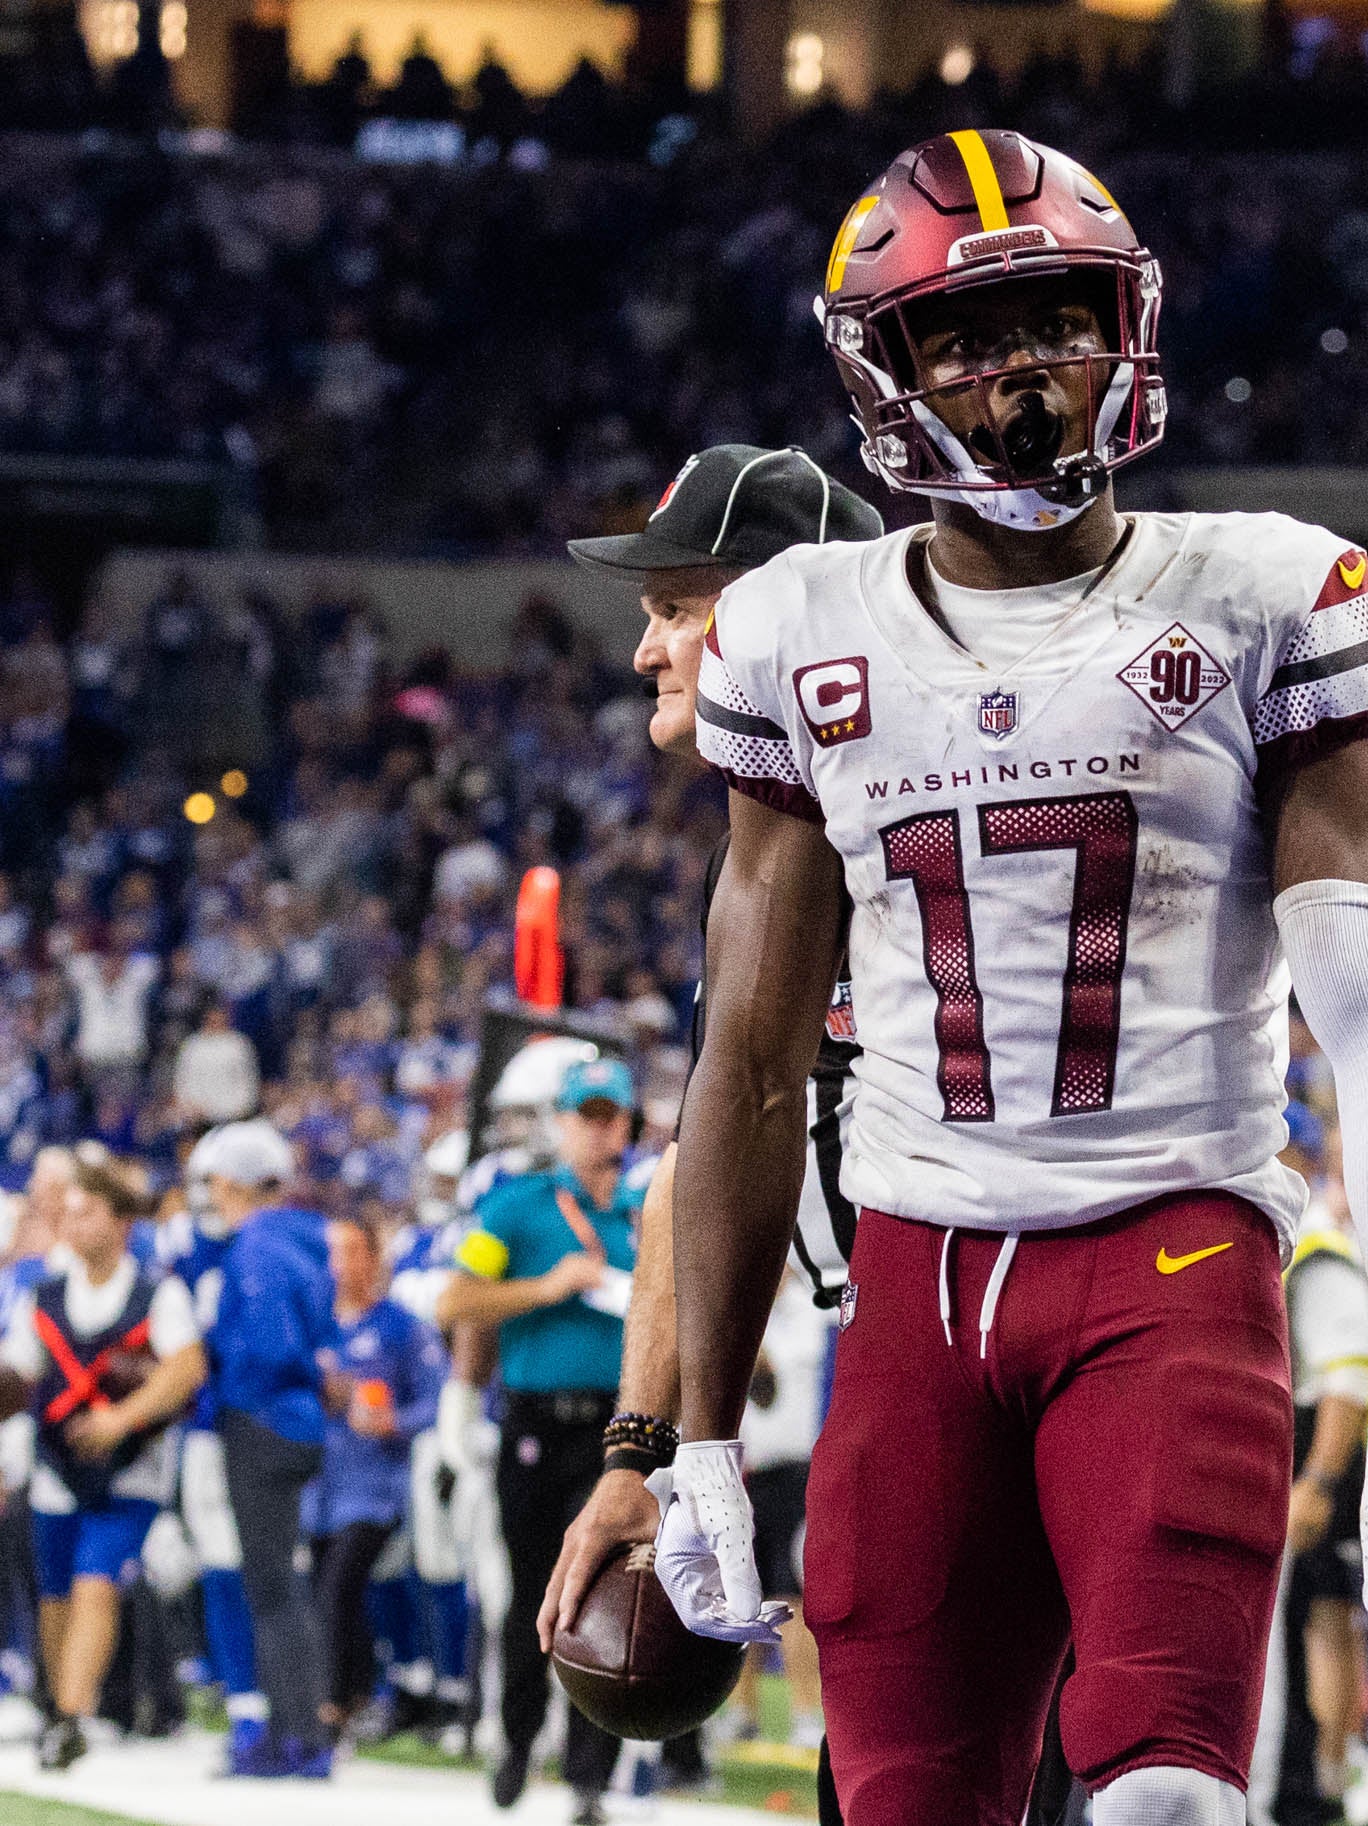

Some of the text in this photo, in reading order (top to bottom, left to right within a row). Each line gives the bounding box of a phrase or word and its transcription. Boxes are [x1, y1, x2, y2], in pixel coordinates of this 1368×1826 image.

[1126, 671, 1148, 679] 1932
[1149, 649, 1201, 705] 90
[1200, 674, 1224, 683] 2022
[799, 663, 862, 726] C
[1159, 705, 1185, 717] YEARS
[982, 708, 1014, 732] NFL
[865, 753, 1140, 800] WASHINGTON
[877, 789, 1140, 1123] 17
